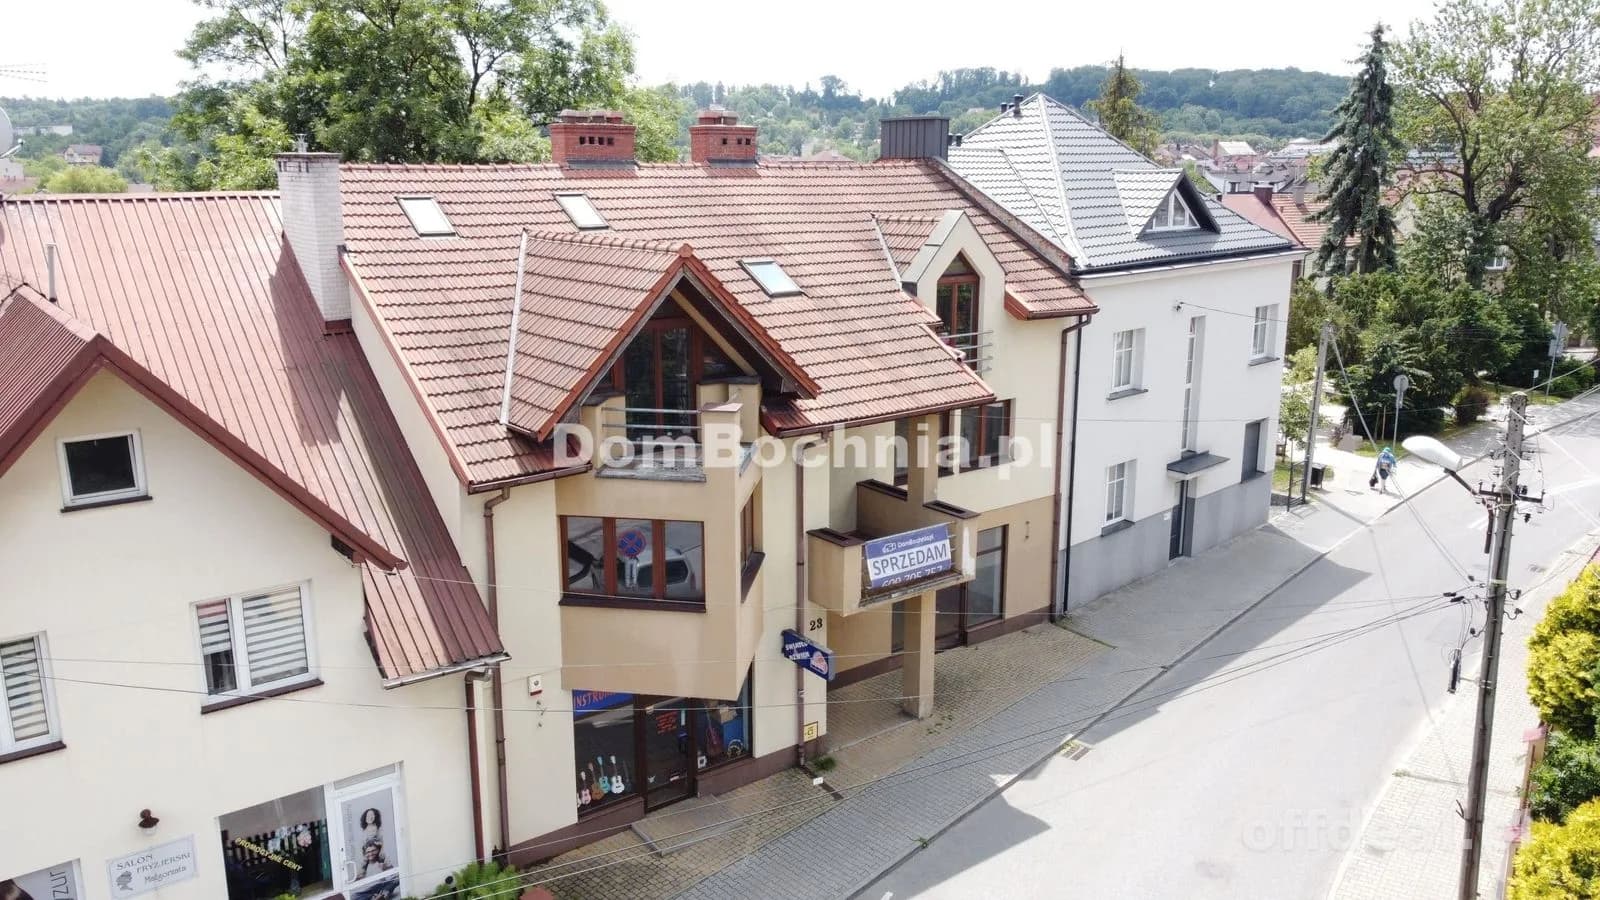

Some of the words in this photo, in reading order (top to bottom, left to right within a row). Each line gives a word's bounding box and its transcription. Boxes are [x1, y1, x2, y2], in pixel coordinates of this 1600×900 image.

[872, 544, 947, 576] SPRZEDAM
[809, 618, 823, 631] 23
[116, 854, 153, 871] SALON
[136, 852, 192, 874] FRYZJERSKI
[282, 859, 303, 872] CENY
